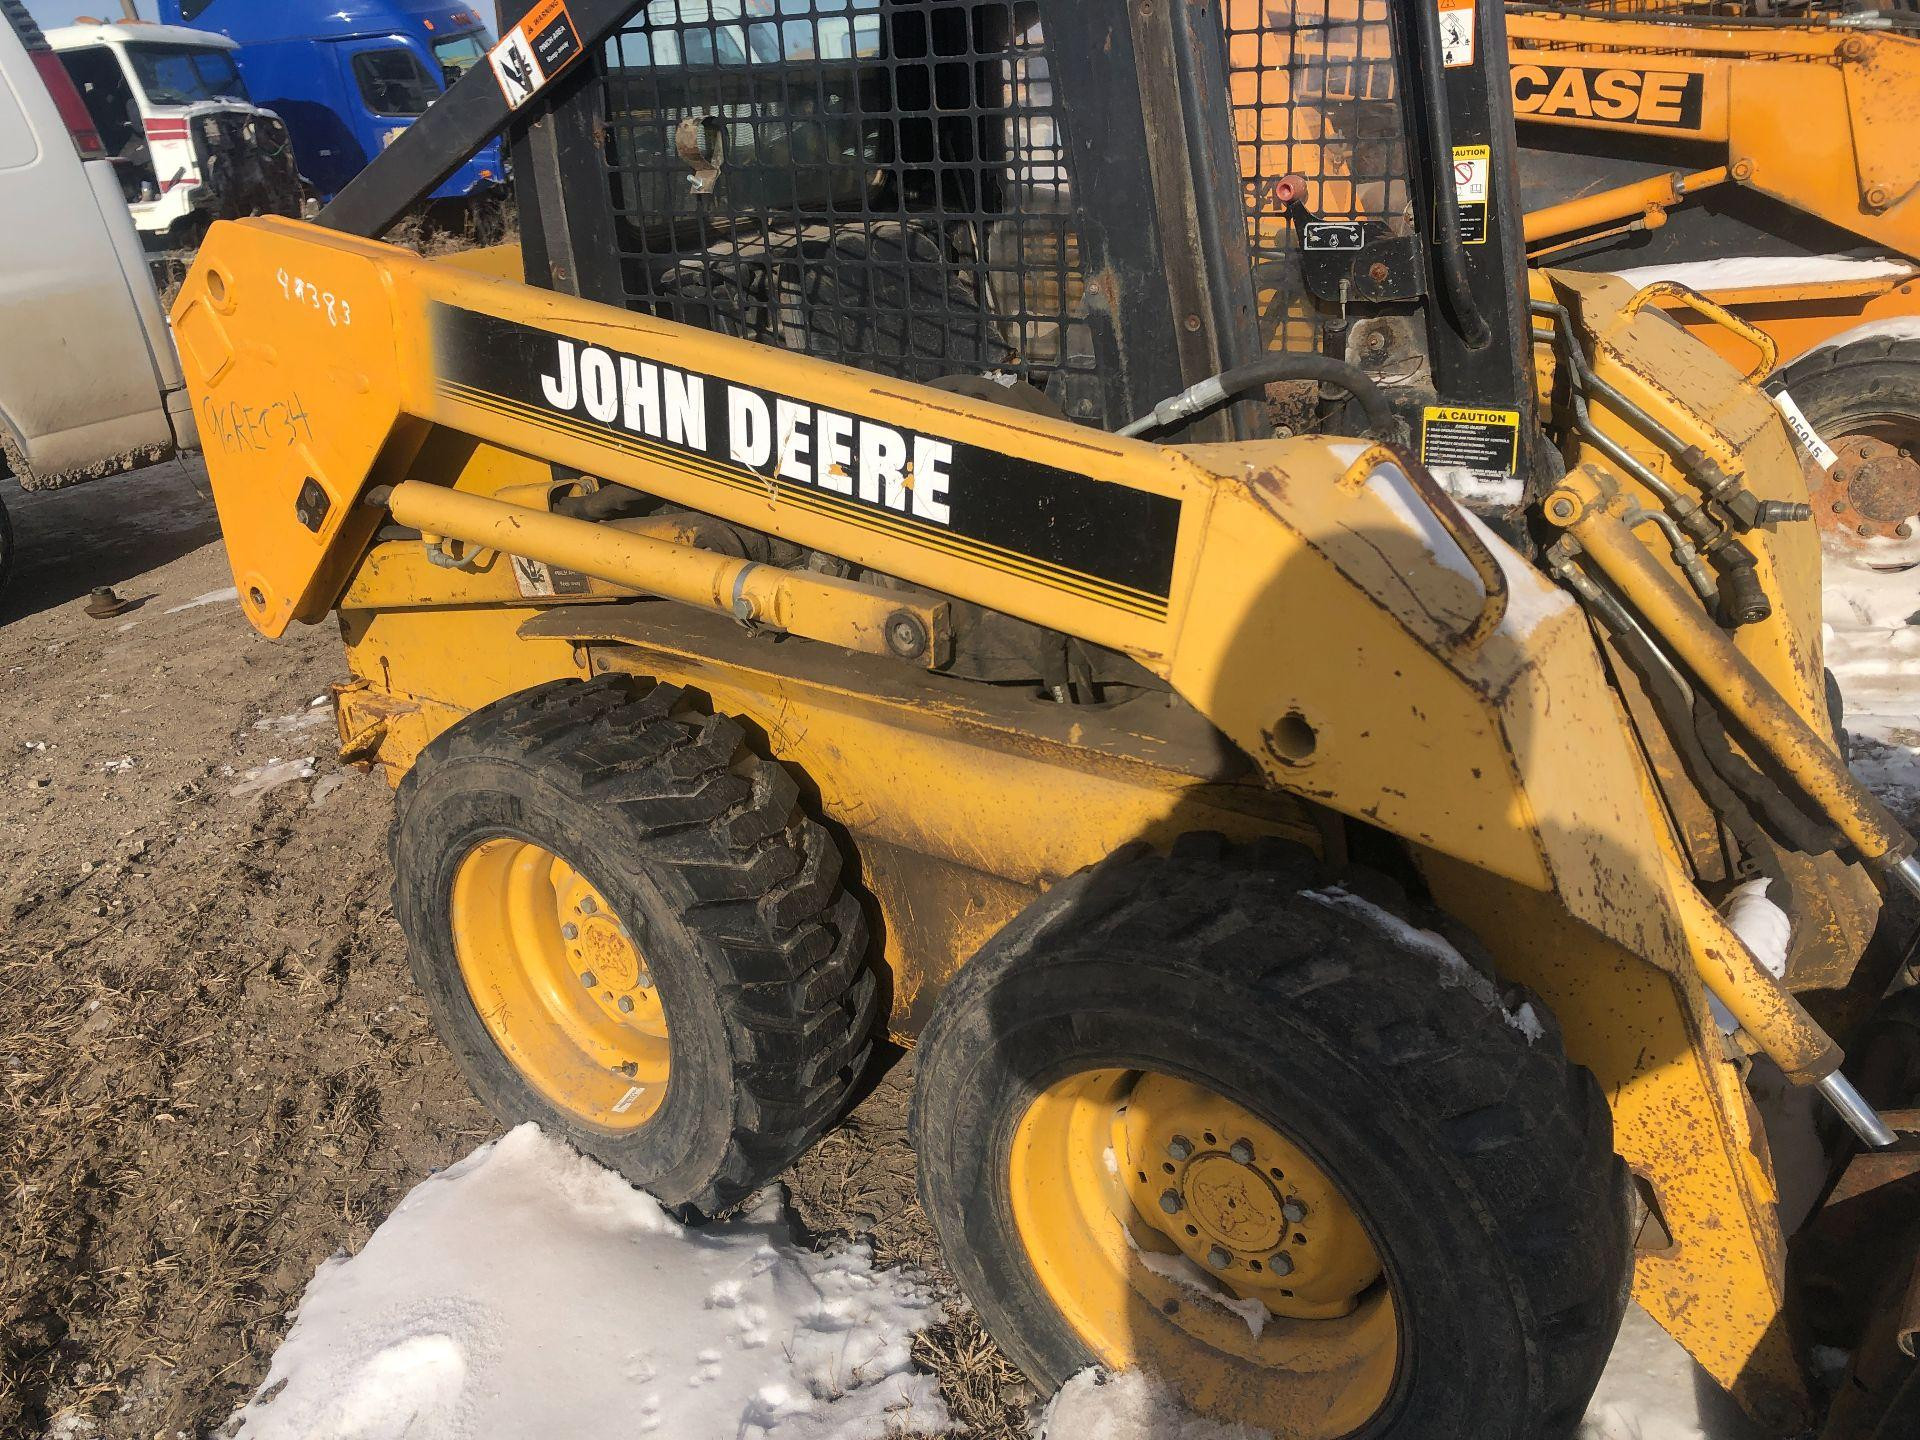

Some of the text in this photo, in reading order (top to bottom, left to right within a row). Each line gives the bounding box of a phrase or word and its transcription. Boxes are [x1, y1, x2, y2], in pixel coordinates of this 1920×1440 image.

[1510, 64, 1689, 122] CASE
[1453, 149, 1486, 157] AUTION
[541, 340, 953, 525] JOHN DEERE
[1451, 412, 1507, 423] CAUTION
